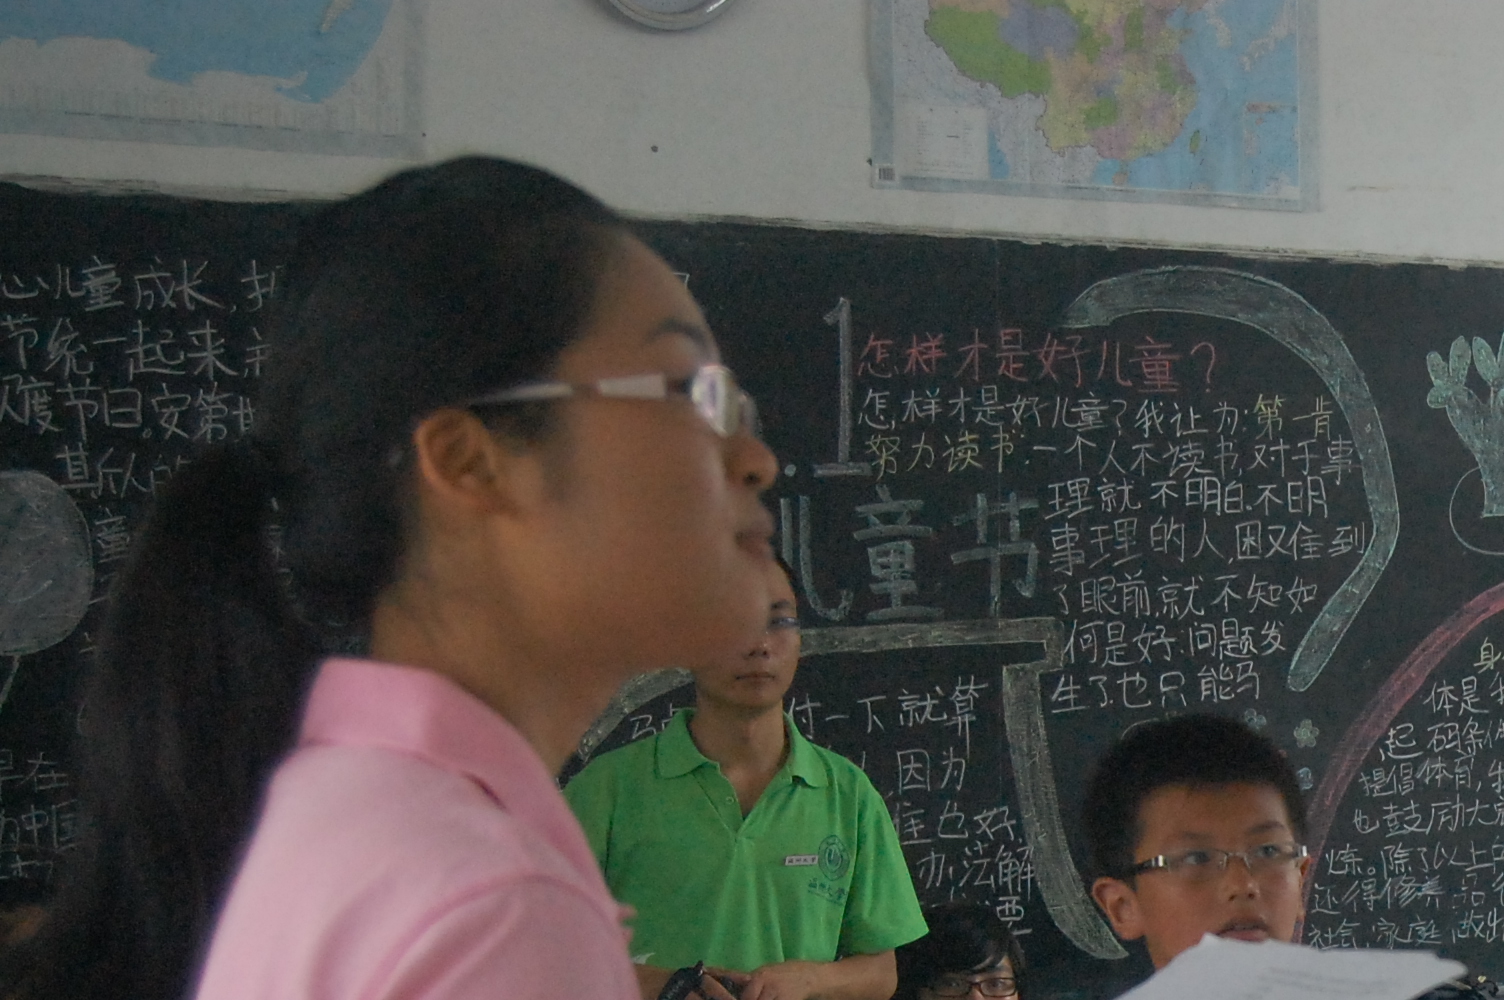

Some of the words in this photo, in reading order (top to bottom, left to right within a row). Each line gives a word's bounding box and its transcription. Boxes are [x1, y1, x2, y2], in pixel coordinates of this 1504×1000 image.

[856, 327, 1217, 393] 怎样才是好儿童?
